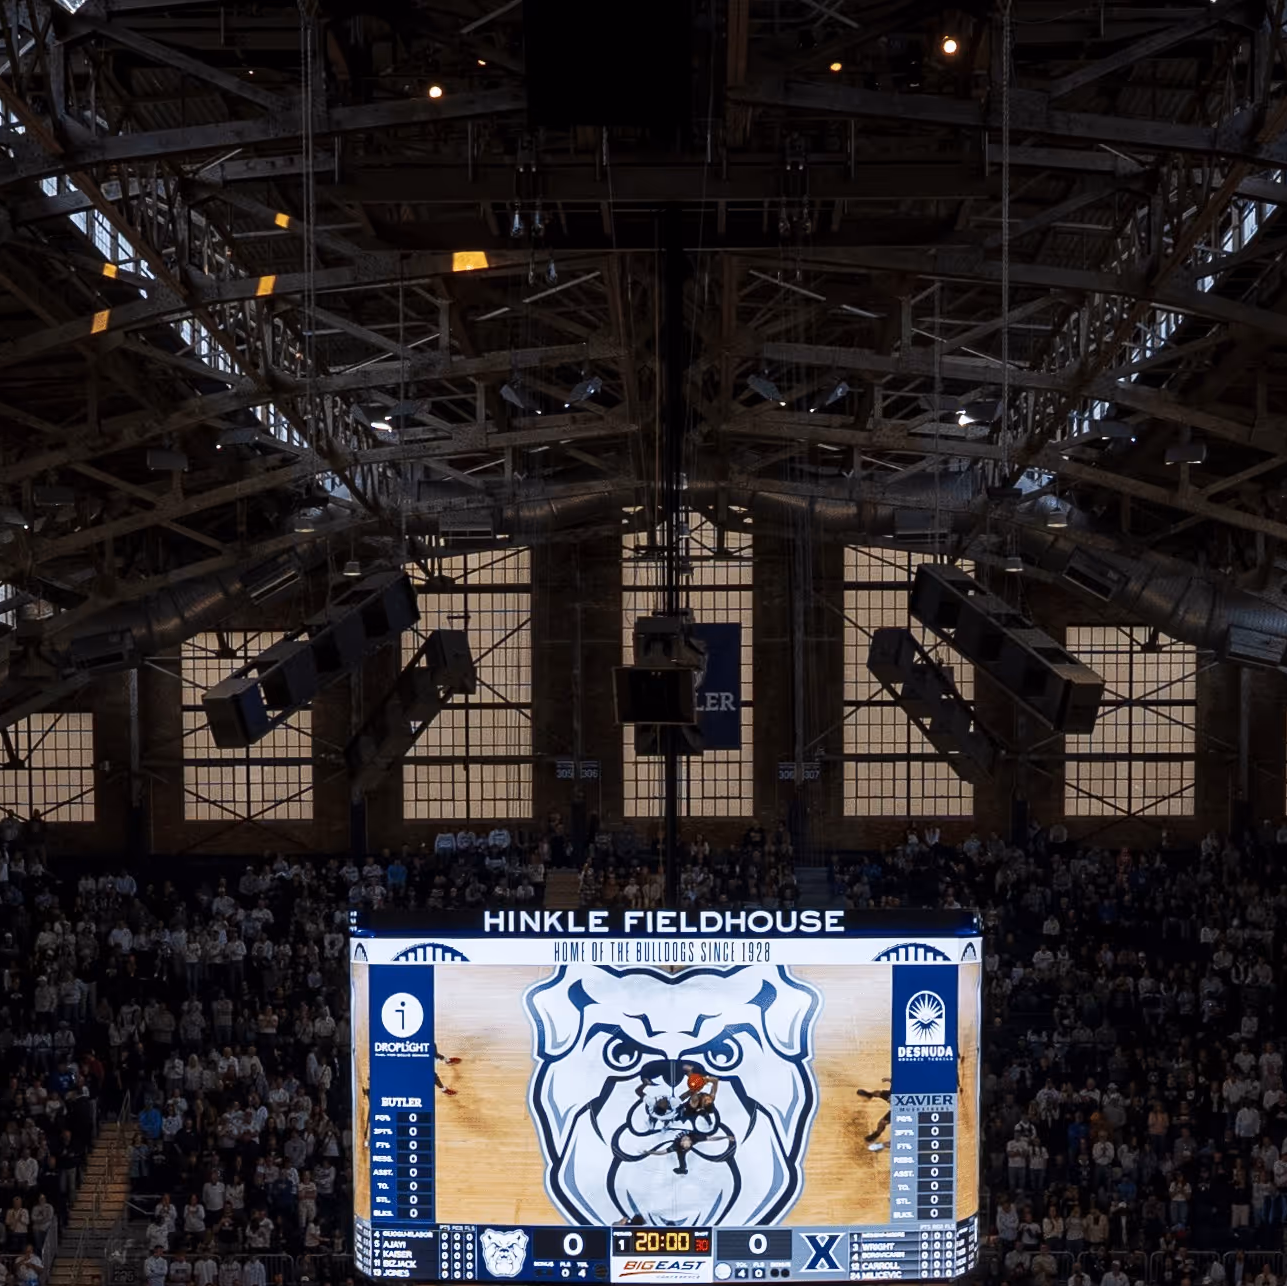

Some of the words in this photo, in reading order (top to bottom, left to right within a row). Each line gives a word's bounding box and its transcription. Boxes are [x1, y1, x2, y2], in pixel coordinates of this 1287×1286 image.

[484, 911, 610, 932] HINKLE
[624, 910, 844, 933] FIELDHOUSE
[554, 942, 584, 962] HOME
[592, 942, 604, 962] OF
[610, 942, 630, 962] THE
[637, 942, 694, 962] BULLDOGS
[701, 942, 735, 962] SINCE
[742, 942, 770, 962] 1928
[898, 1046, 953, 1058] DESNUDA
[381, 1097, 422, 1107] BUTLER
[895, 1095, 953, 1106] XAVIER
[373, 1169, 394, 1177] ASST.
[893, 1170, 914, 1178] ASST.
[563, 1233, 583, 1256] 0
[618, 1239, 625, 1250] 1
[696, 1240, 708, 1251] 30
[635, 1232, 690, 1252] 20:00
[749, 1233, 768, 1255] 0
[578, 1268, 586, 1277] 4
[737, 1268, 746, 1277] 4
